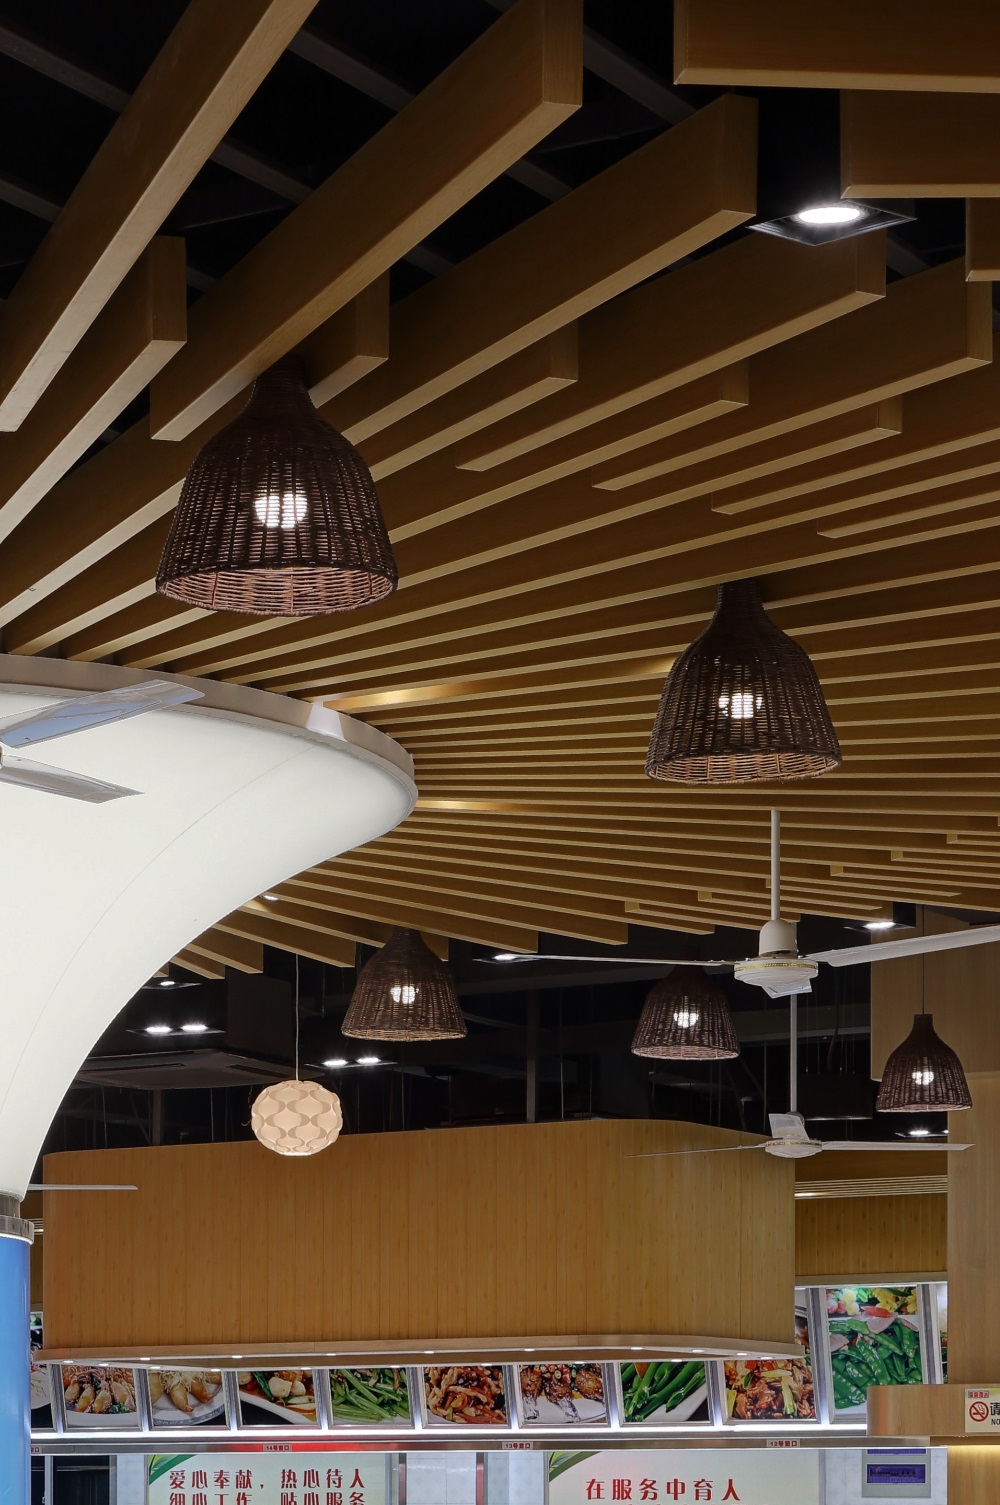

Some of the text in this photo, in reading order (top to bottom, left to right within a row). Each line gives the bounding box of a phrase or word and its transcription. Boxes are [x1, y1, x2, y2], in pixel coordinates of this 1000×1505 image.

[169, 1468, 366, 1490] 爱心奉献，热心待人
[585, 1478, 741, 1501] 在服务中育人
